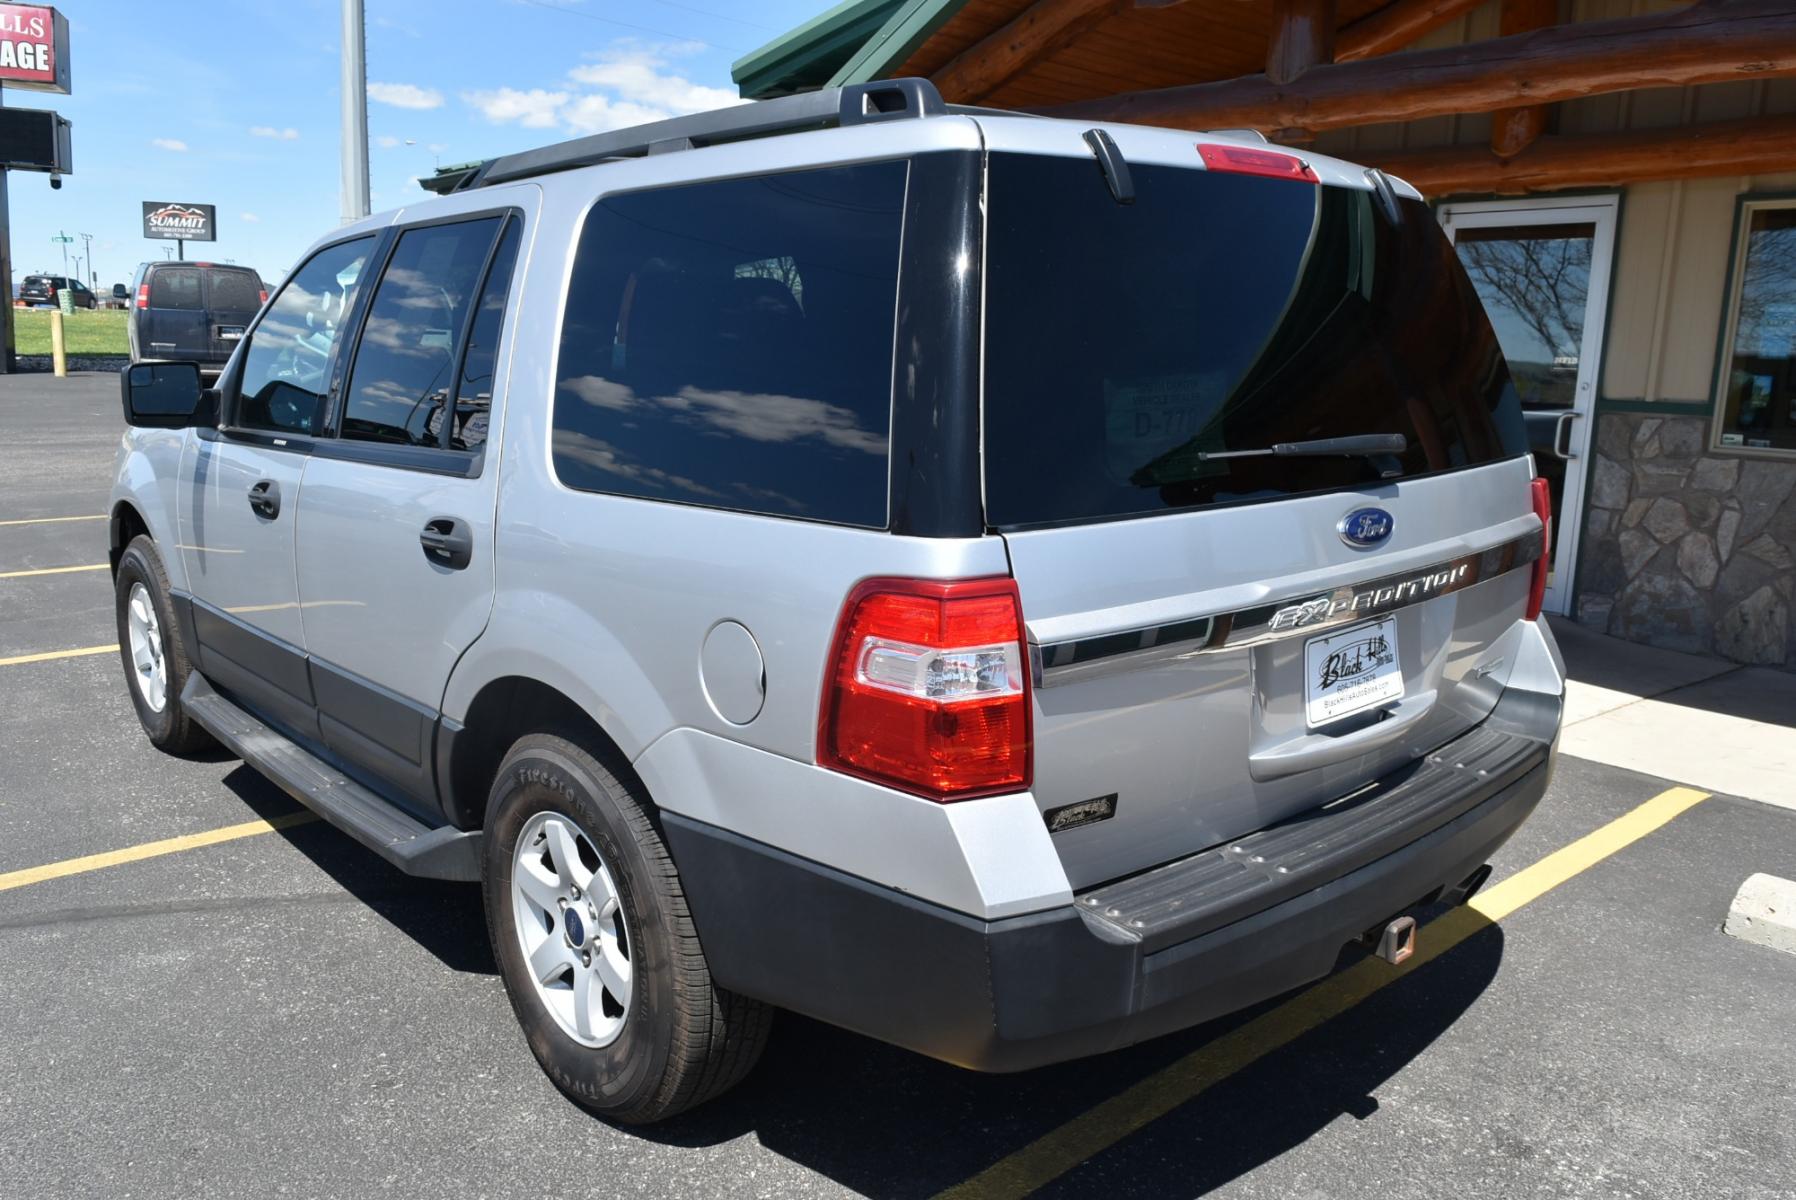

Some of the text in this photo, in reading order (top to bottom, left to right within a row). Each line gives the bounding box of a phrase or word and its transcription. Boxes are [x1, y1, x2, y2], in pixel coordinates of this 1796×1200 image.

[0, 40, 49, 71] AGE
[149, 215, 206, 228] SUMMIT
[1357, 513, 1388, 539] Ford
[1268, 564, 1468, 632] EXPEDITION
[1316, 646, 1363, 691] Black
